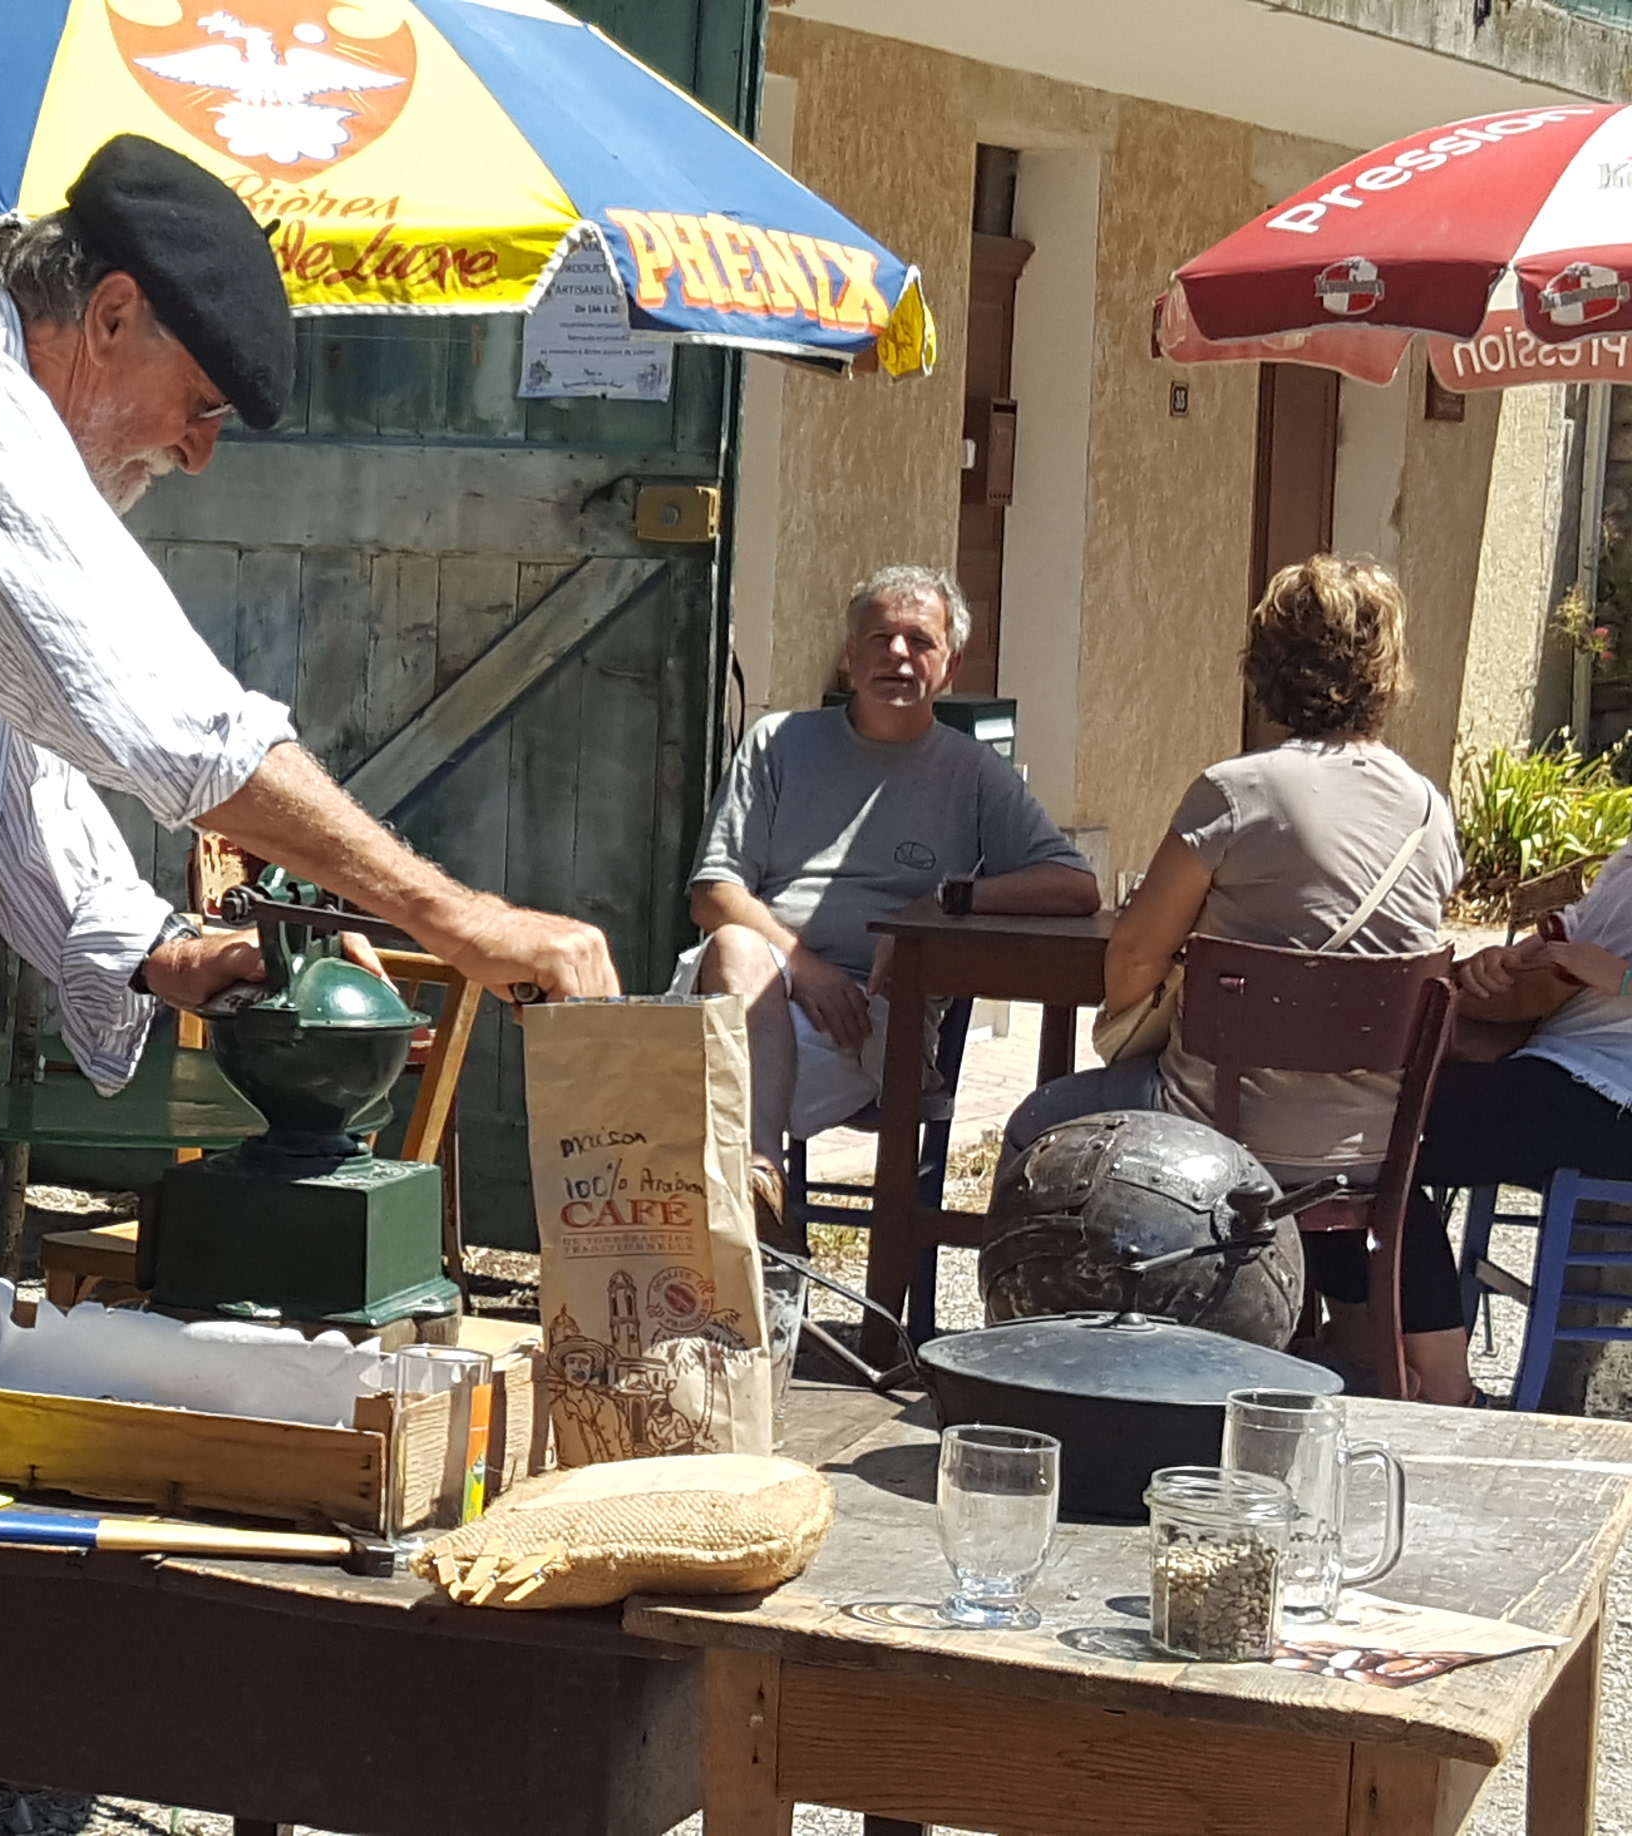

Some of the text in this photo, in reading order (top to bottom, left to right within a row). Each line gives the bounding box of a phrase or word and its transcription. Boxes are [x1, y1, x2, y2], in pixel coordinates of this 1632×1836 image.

[1266, 108, 1594, 234] Pression
[323, 222, 500, 293] Luxe
[564, 1158, 628, 1200] 100%
[560, 1194, 693, 1228] CAFÉ
